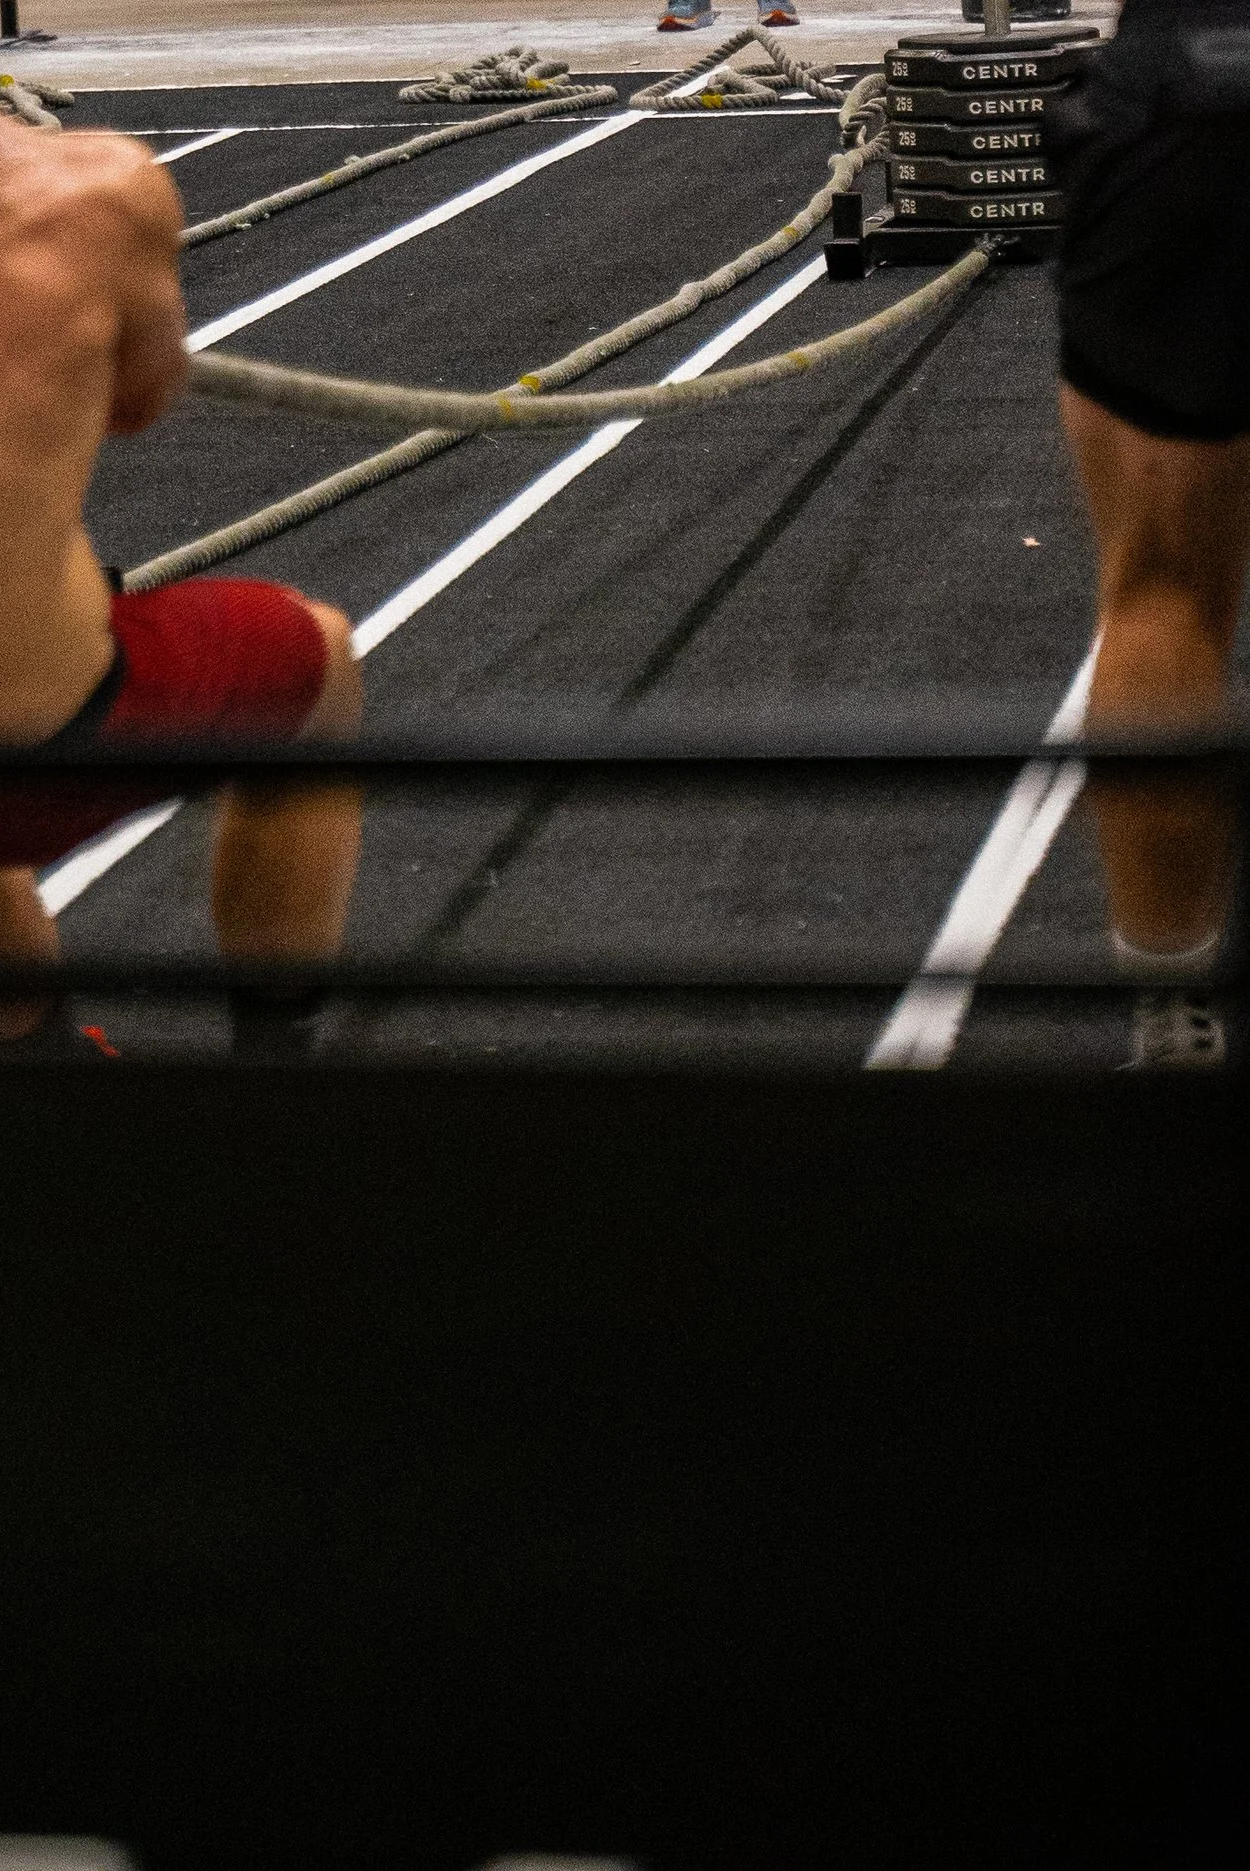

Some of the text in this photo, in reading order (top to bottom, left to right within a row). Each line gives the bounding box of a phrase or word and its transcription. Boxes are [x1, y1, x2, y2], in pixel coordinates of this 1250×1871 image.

[963, 63, 1038, 80] CENTR
[969, 97, 1044, 115] CENTR
[970, 168, 1045, 184] CENTR
[970, 202, 1045, 218] CENTR
